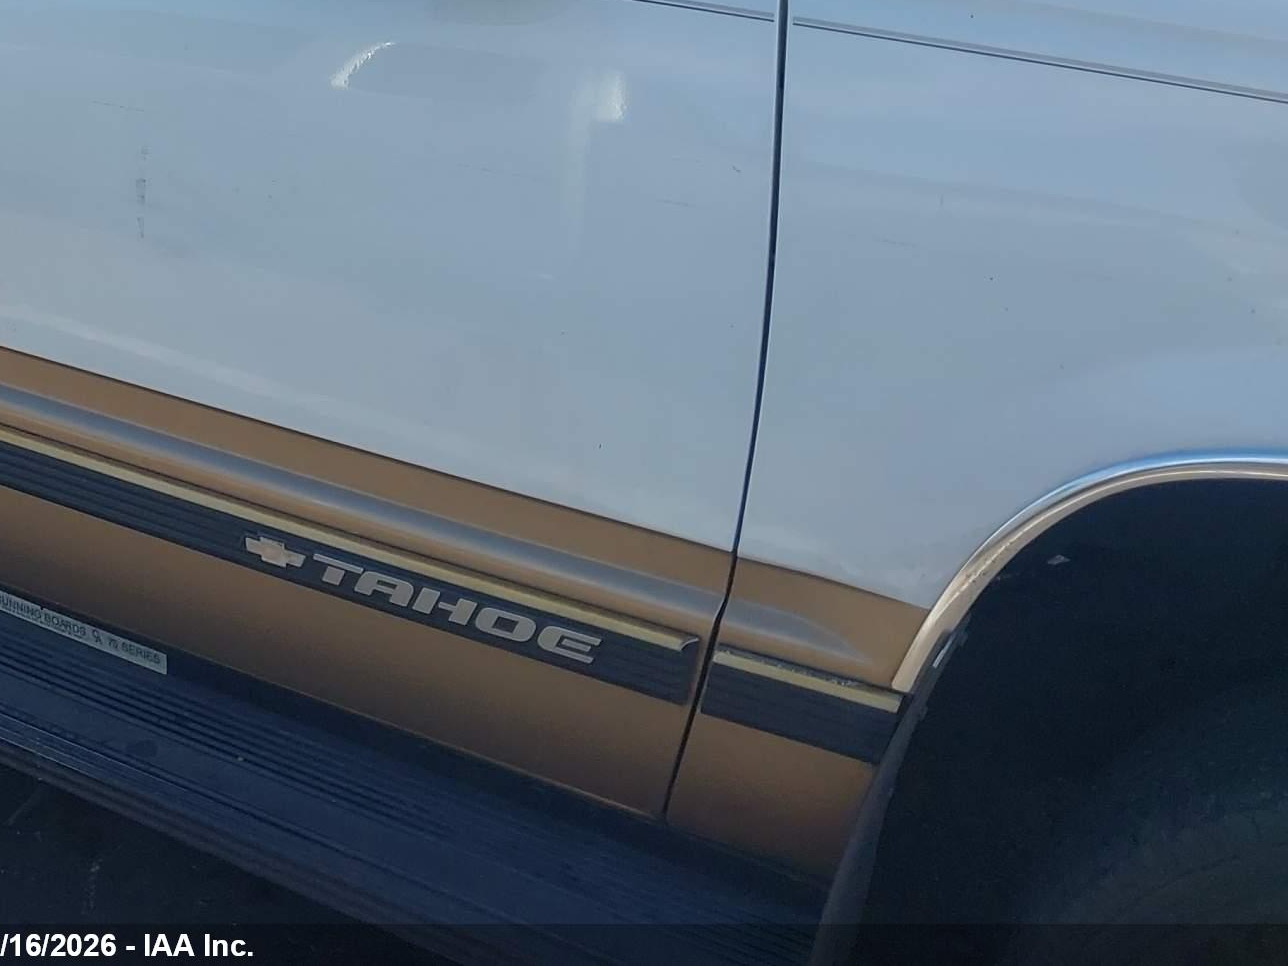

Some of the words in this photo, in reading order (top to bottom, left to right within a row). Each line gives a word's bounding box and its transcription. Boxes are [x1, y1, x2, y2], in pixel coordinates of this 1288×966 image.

[44, 612, 87, 636] BOARDS
[122, 642, 161, 664] SERIES
[313, 553, 602, 664] TAHOE
